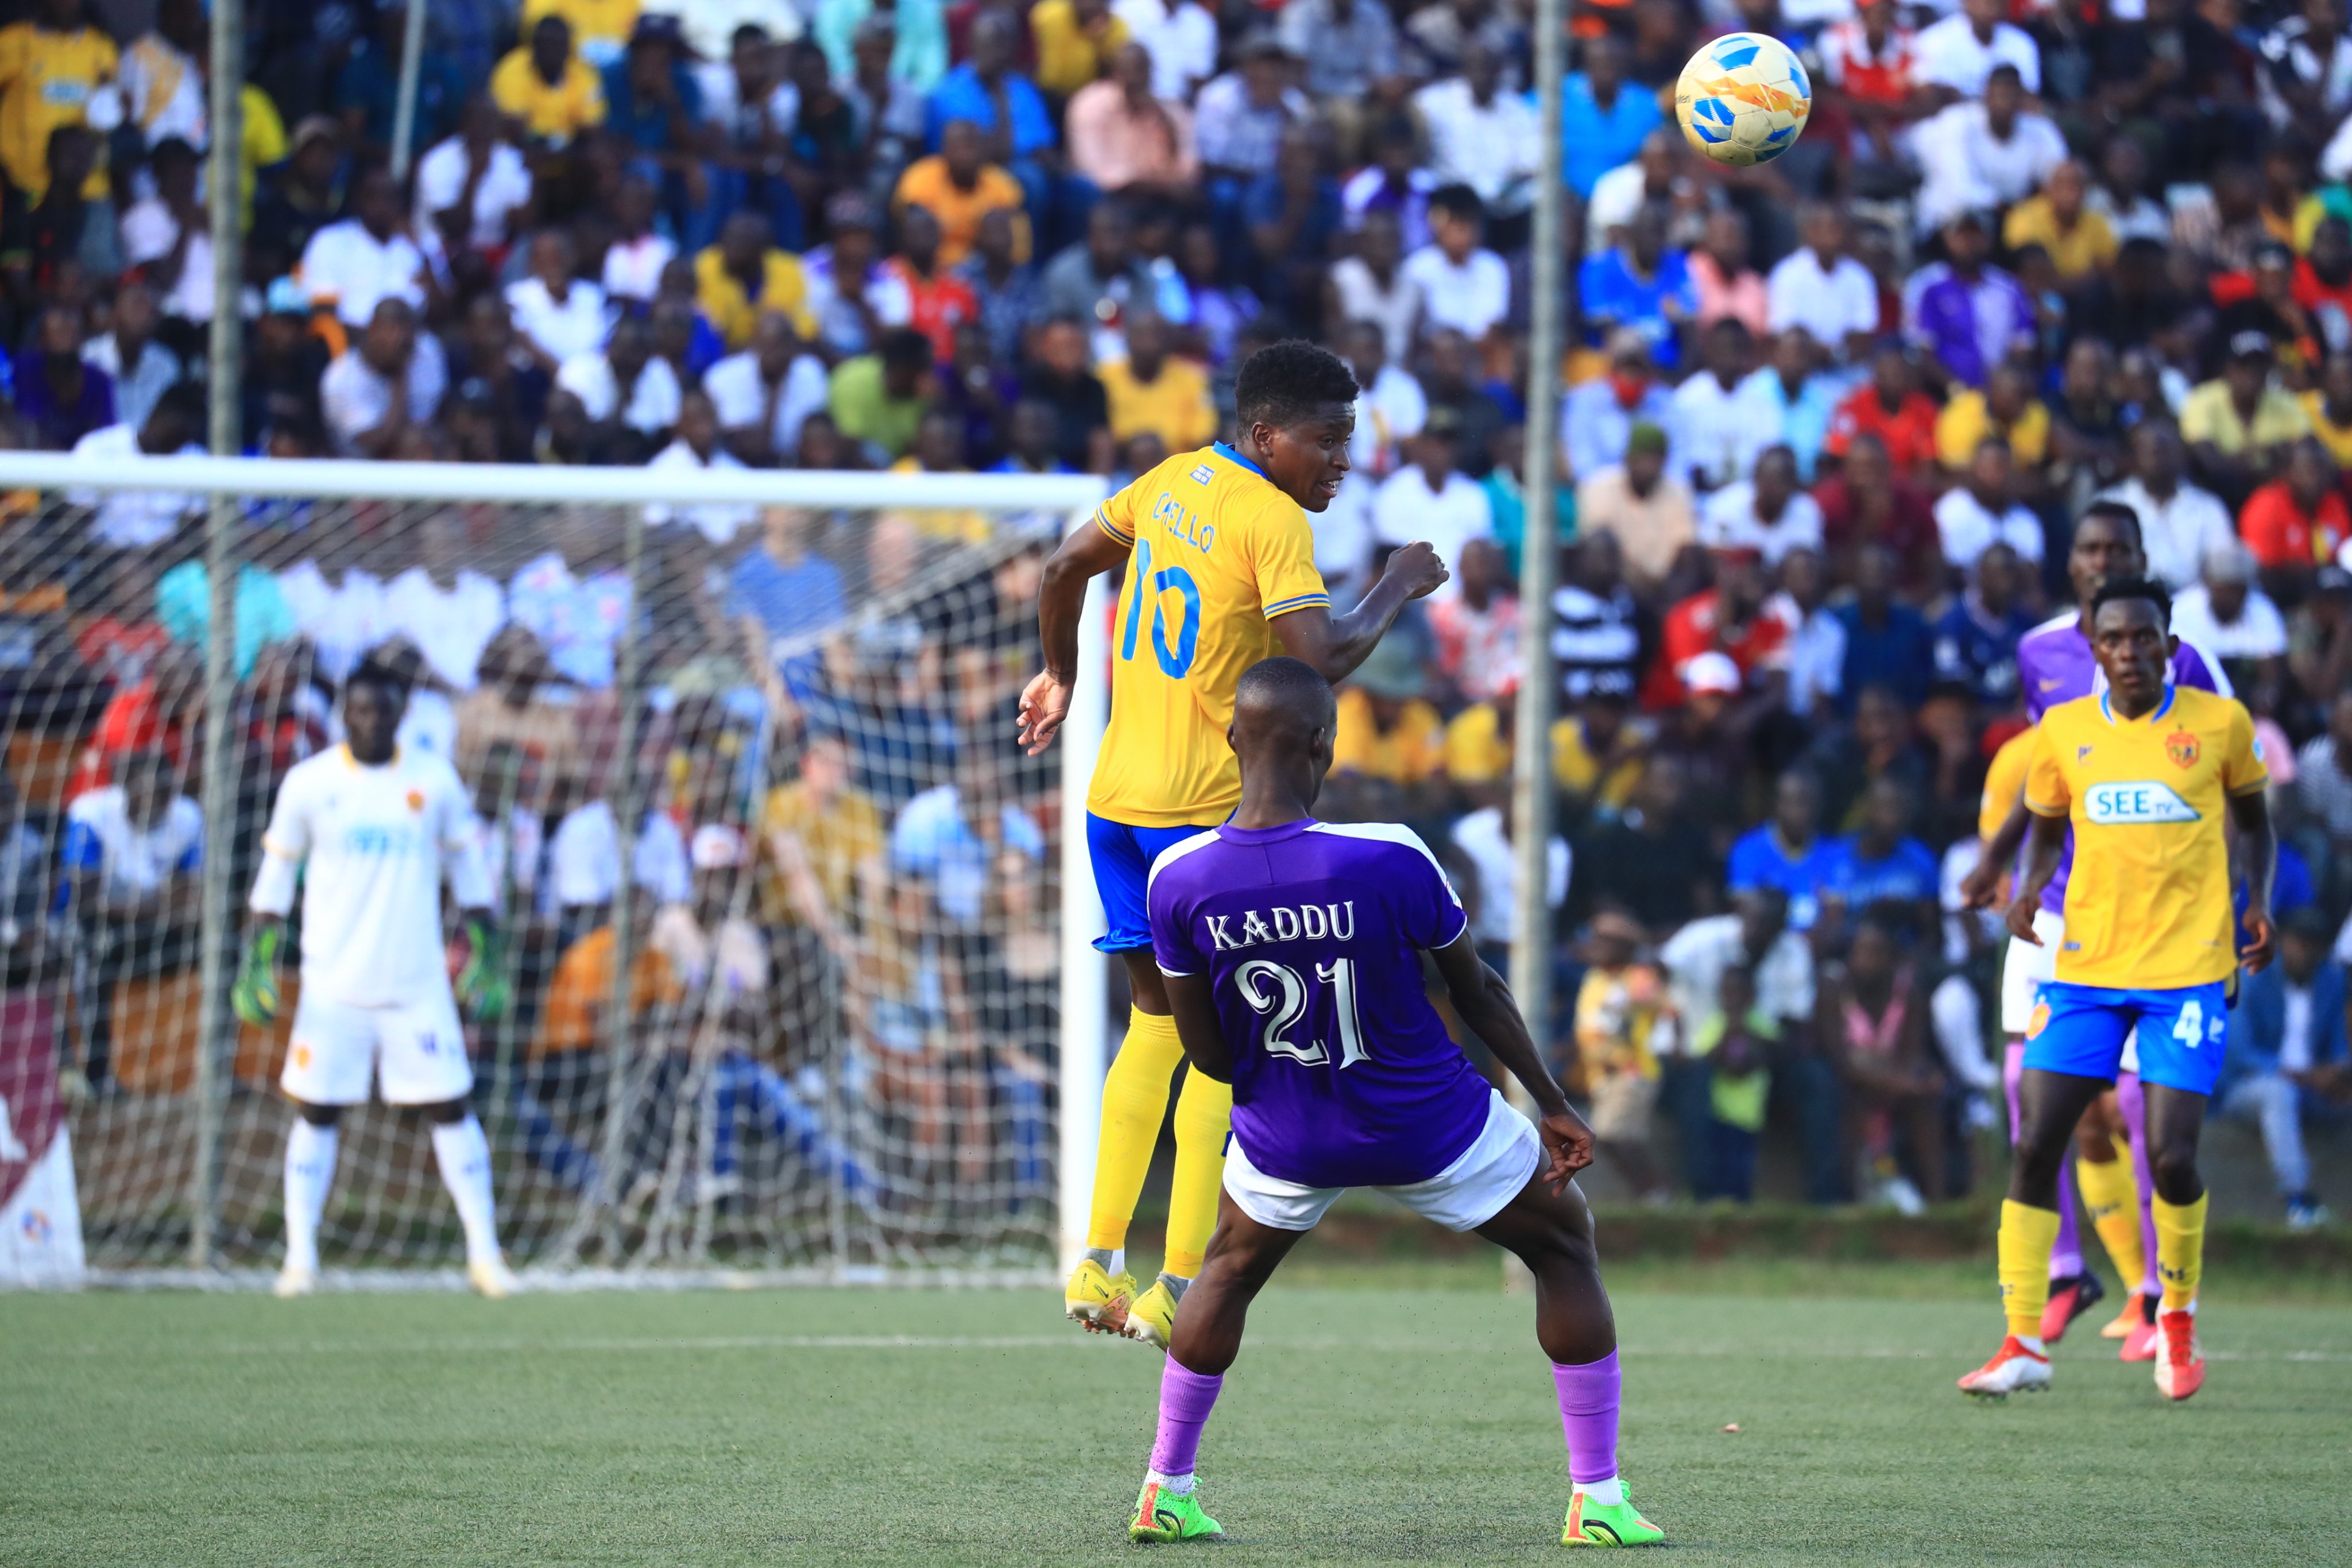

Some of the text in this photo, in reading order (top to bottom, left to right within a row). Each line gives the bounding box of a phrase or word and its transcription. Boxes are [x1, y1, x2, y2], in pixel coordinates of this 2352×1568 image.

[1121, 538, 1201, 679] 10
[2097, 788, 2173, 816] SEE TV
[1205, 900, 1354, 951] KADDU
[1233, 957, 1372, 1071] 21
[2172, 999, 2203, 1049] 4
